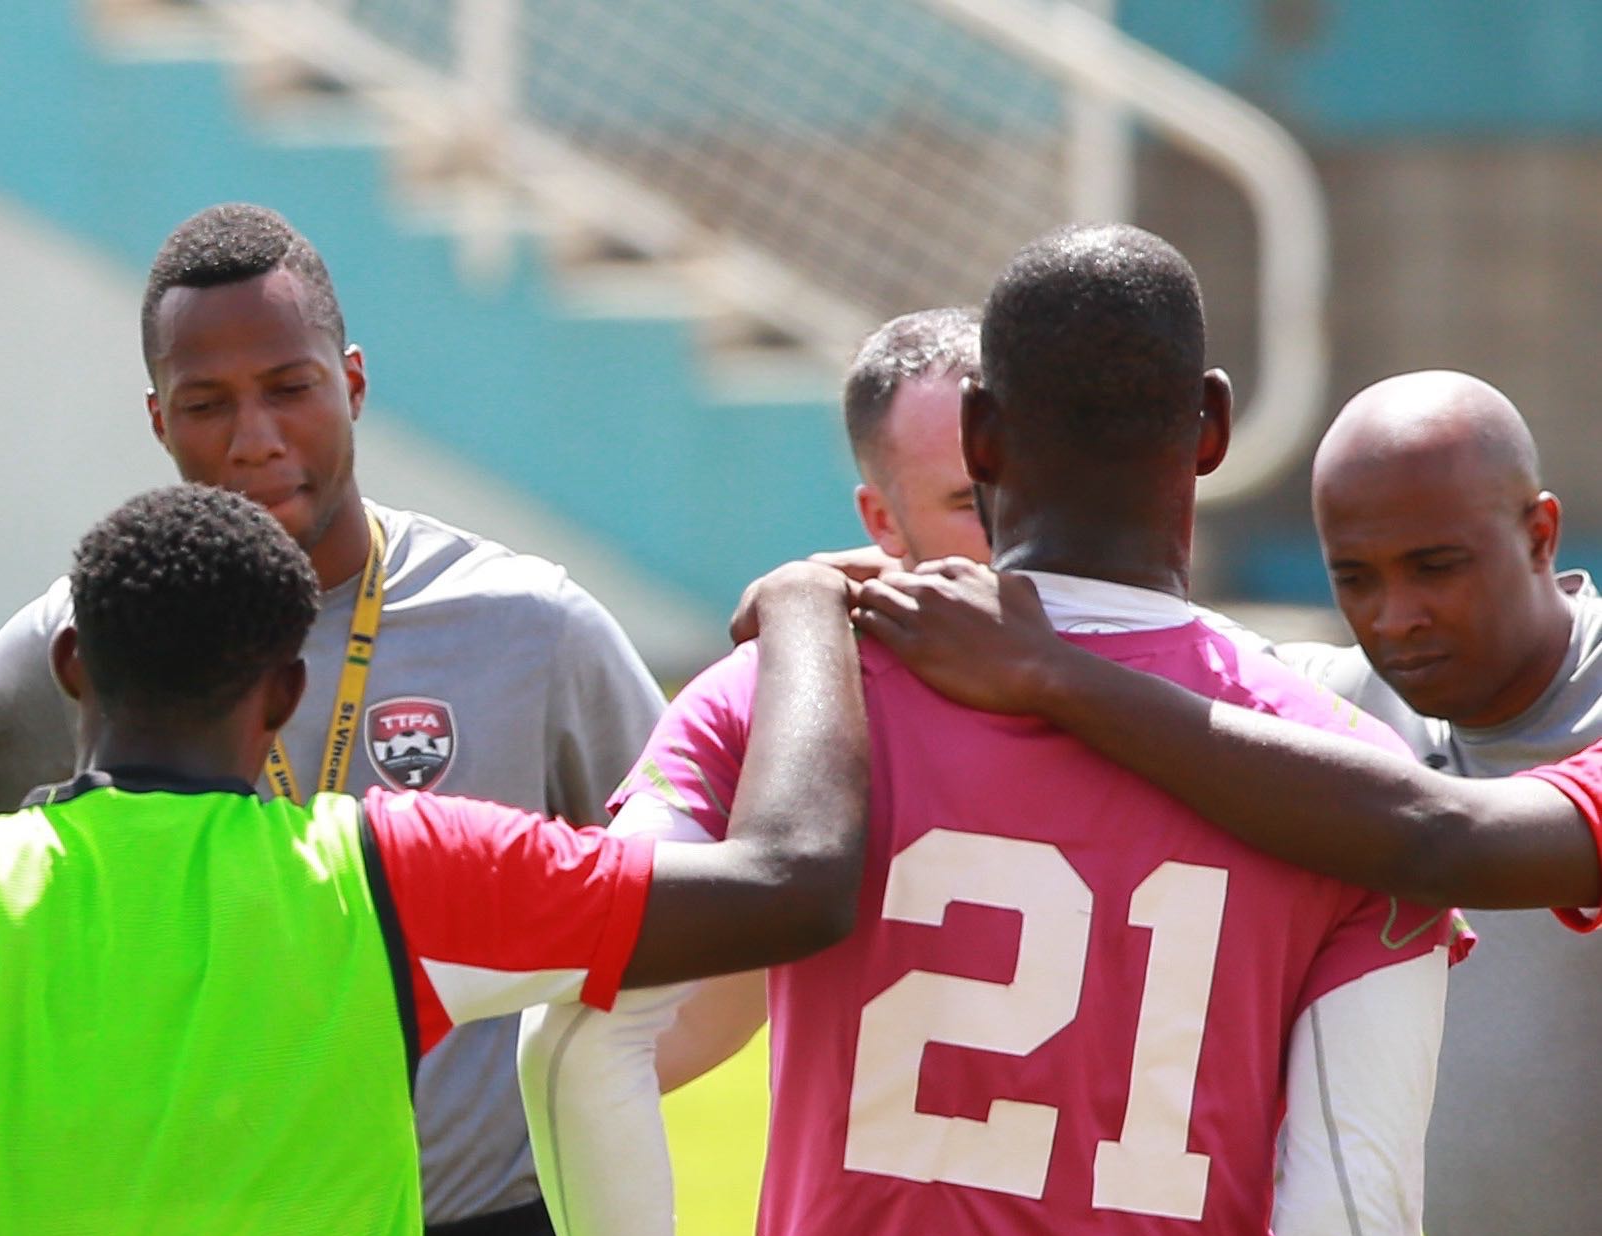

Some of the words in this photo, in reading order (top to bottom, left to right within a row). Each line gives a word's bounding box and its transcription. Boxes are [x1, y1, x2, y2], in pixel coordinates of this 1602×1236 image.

[379, 712, 440, 730] TTFA
[325, 728, 350, 791] Vincen
[843, 827, 1229, 1221] 21
